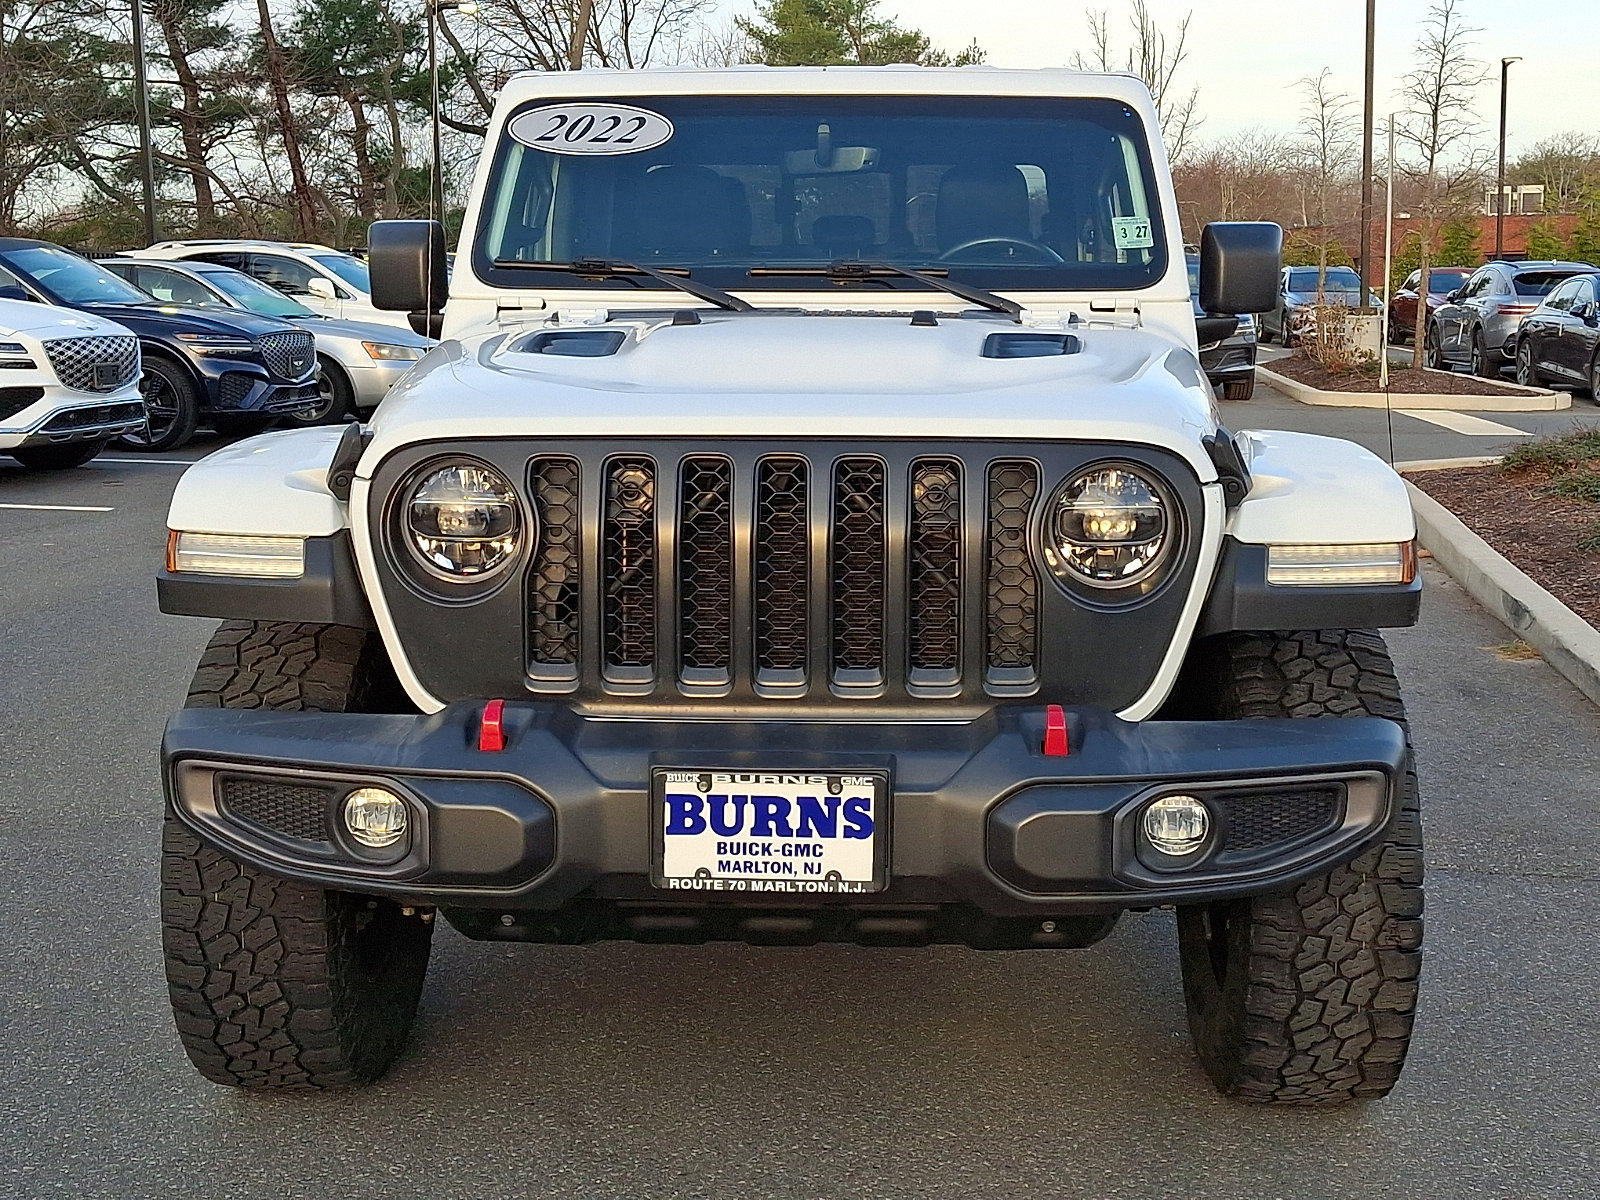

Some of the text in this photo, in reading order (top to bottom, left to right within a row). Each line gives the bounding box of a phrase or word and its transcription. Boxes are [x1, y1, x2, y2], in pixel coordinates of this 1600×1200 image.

[533, 114, 647, 144] 2022
[1120, 225, 1148, 239] 3 27
[666, 773, 873, 786] BUICK BURNS GMC
[665, 793, 875, 839] BURNS
[716, 841, 824, 858] BUICK-GMC
[717, 860, 822, 877] MARLTON, NJ
[669, 878, 867, 893] ROUTE 70 MARLTON, N.J.
